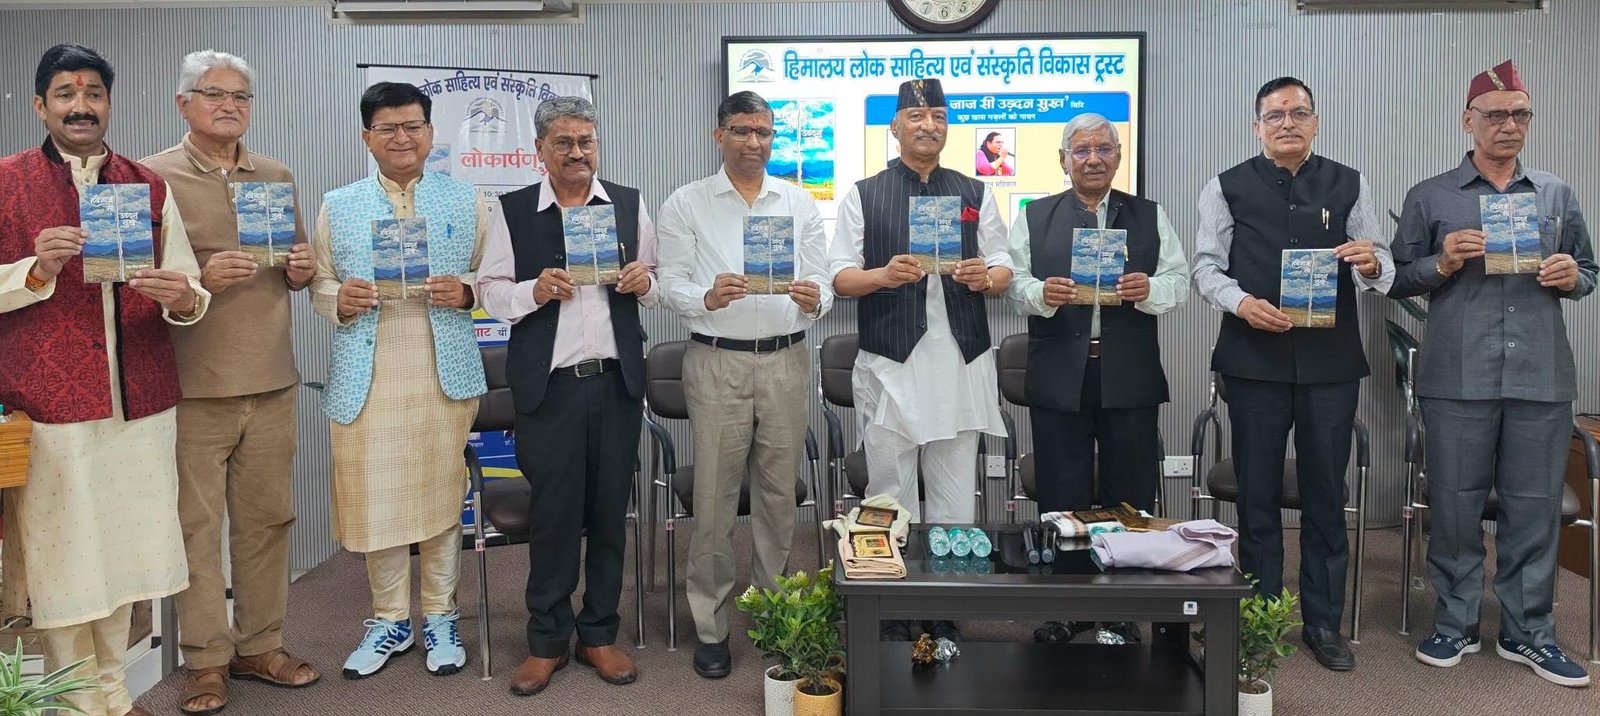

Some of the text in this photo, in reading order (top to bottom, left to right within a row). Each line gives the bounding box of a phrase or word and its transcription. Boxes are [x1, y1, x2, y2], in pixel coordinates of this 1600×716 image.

[922, 2, 930, 14] 7
[941, 6, 949, 18] 6
[959, 1, 967, 13] 5
[784, 50, 845, 80] हिमालय
[850, 51, 886, 79] लोक
[891, 48, 945, 80] साहित्य
[950, 48, 973, 77] एवं
[977, 47, 1034, 84] संस्कृति
[1039, 47, 1091, 75] विकास
[1095, 54, 1125, 82] ट्रस्ट
[444, 70, 481, 93] साहित्य
[484, 71, 500, 91] एवं
[501, 73, 538, 101] संस्कृति
[460, 147, 539, 169] लोकार्पण
